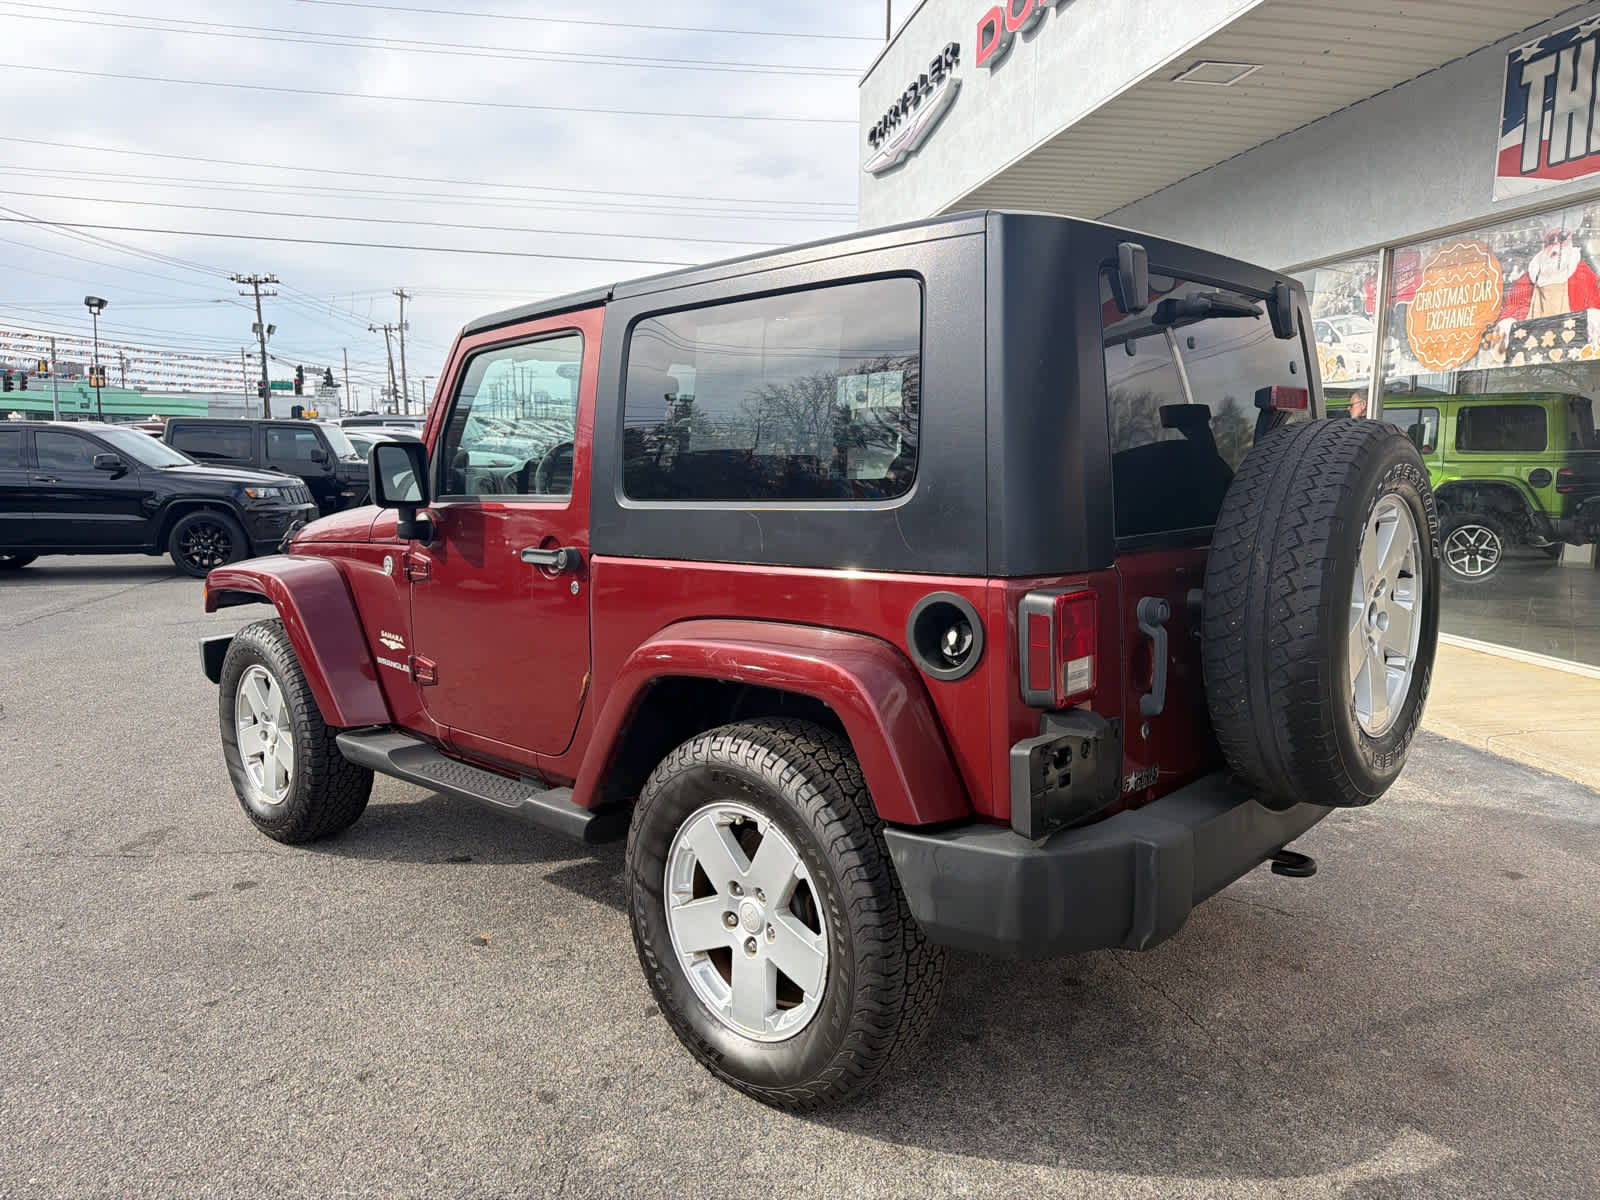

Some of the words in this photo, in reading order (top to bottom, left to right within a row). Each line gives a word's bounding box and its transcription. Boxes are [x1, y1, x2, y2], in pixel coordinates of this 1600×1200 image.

[976, 0, 1048, 68] DO
[1519, 34, 1600, 175] TH
[1415, 284, 1470, 312] CHRISTMAS
[1472, 279, 1493, 303] CAR
[1425, 305, 1477, 332] EXCHANGE
[381, 630, 404, 643] SAHARA
